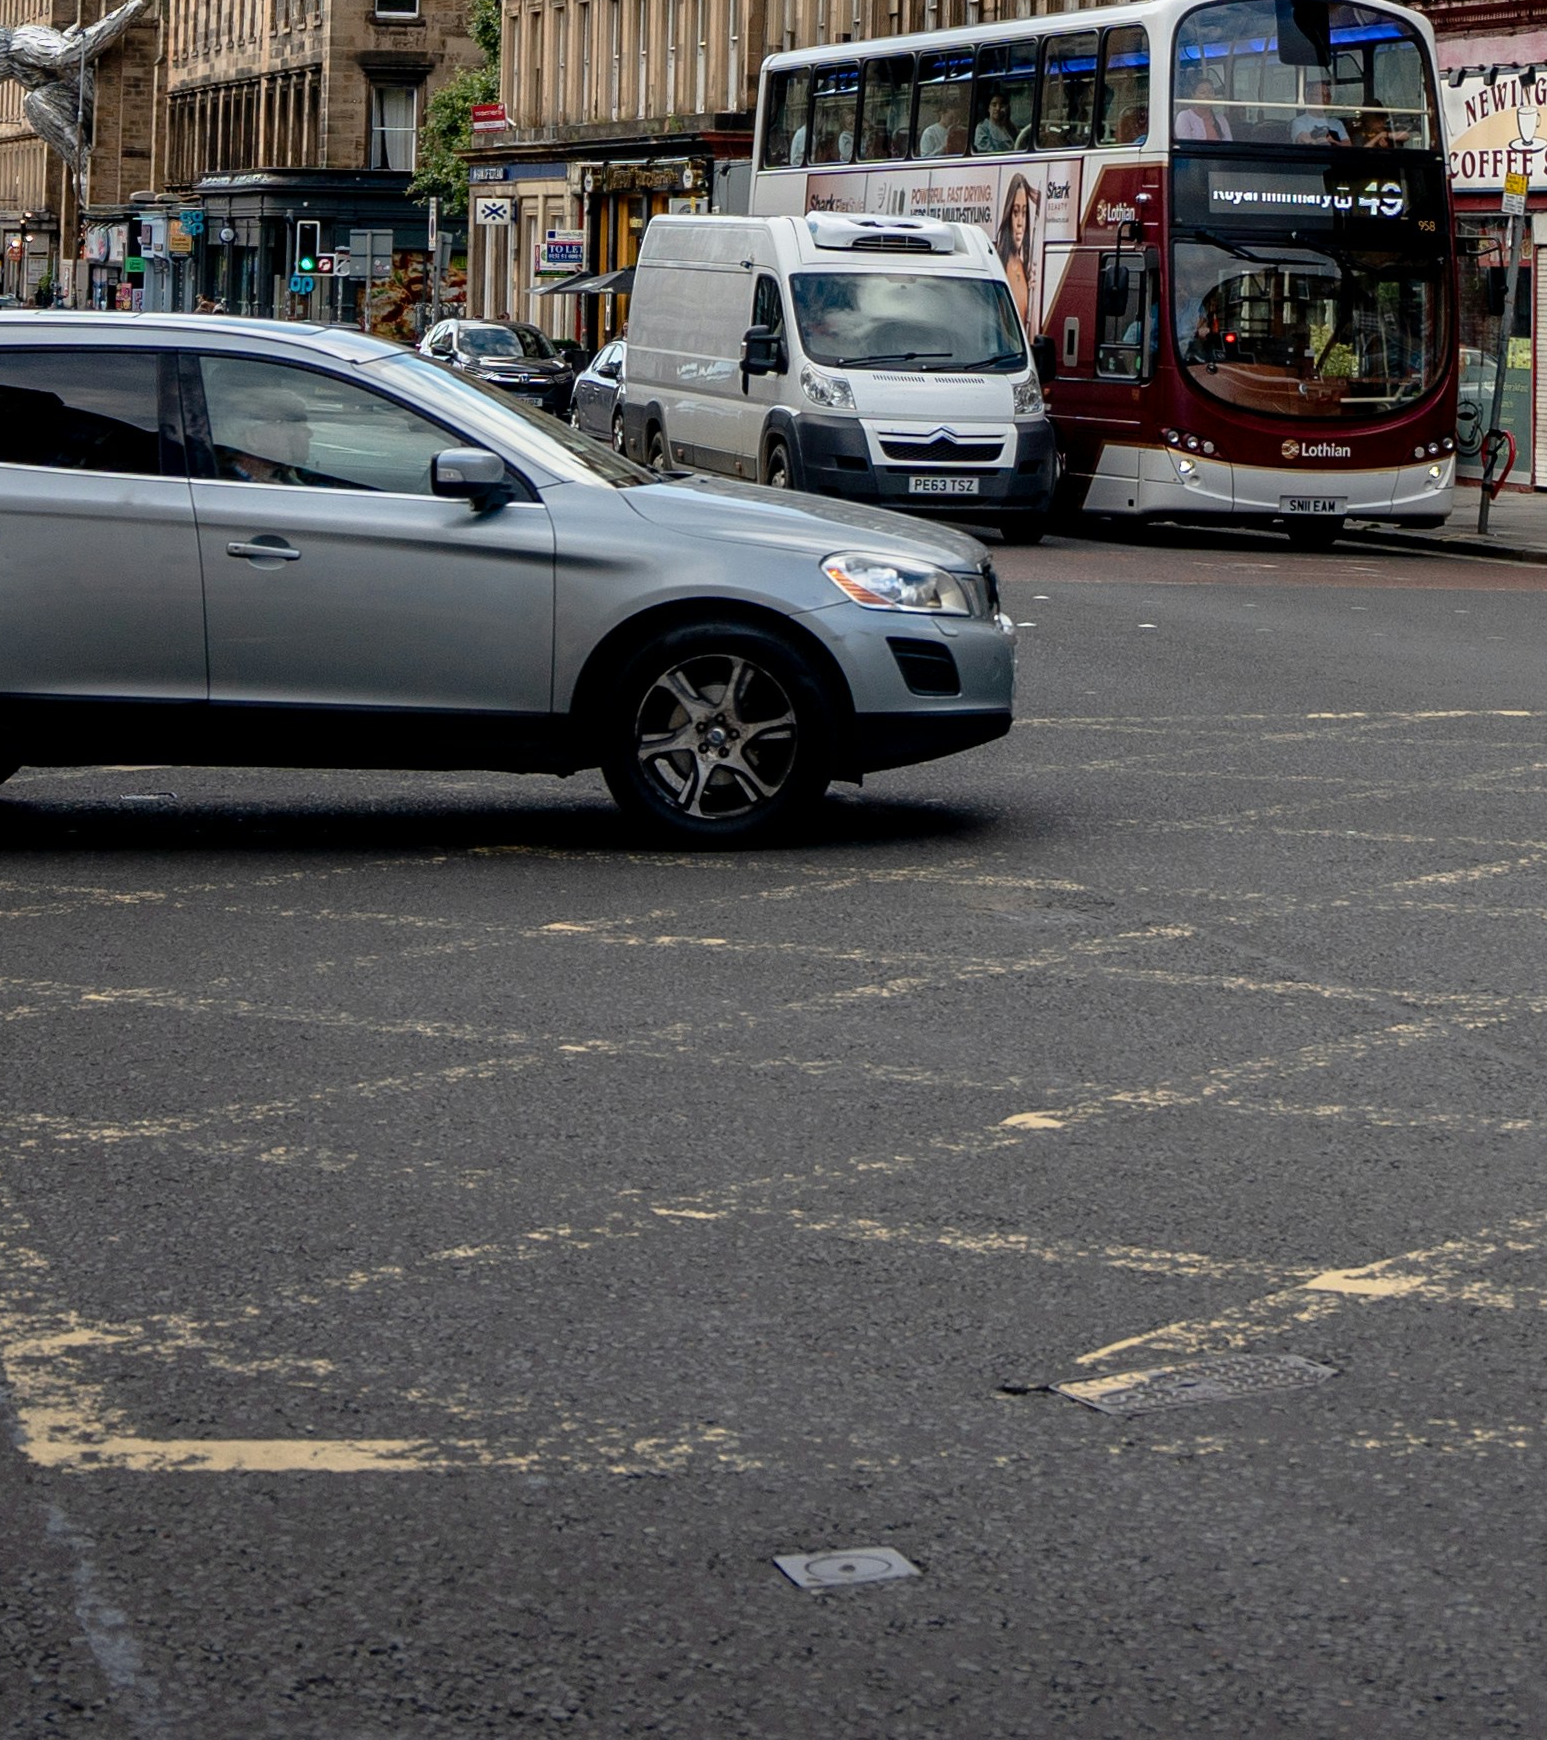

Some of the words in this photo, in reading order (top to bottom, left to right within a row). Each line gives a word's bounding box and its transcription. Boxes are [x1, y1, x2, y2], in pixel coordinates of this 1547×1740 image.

[1448, 149, 1534, 179] COFFEE
[946, 186, 963, 202] FAST
[1048, 180, 1071, 200] Shark
[1358, 181, 1404, 217] 49
[810, 193, 835, 212] Shark
[1107, 203, 1136, 222] Lothian
[1418, 220, 1436, 232] 958
[548, 244, 563, 254] TO
[1301, 441, 1351, 459] Lothian
[914, 478, 947, 493] PE63
[950, 478, 974, 493] TSZ
[1313, 499, 1336, 513] EAM
